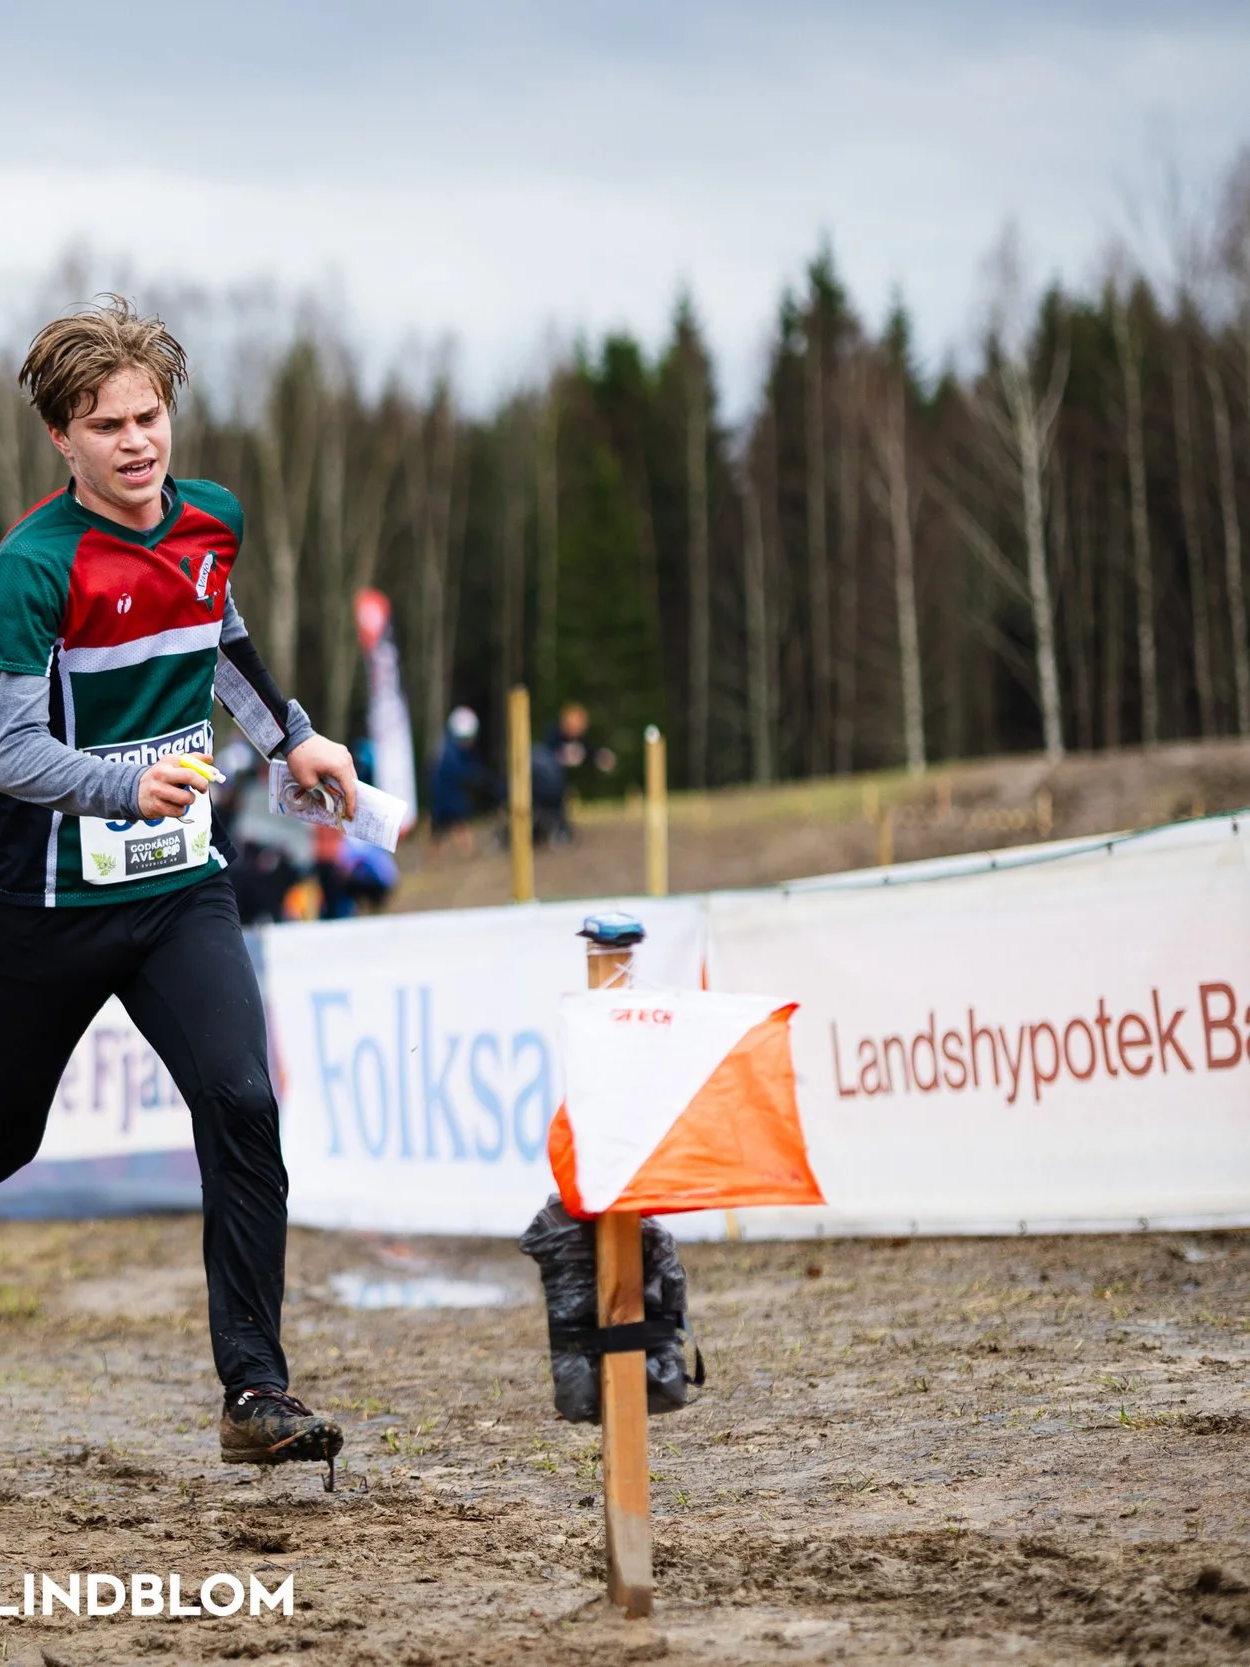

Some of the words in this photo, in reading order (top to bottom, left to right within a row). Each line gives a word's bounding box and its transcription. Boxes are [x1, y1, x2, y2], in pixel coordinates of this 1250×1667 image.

[130, 835, 181, 853] GODKÄNDA
[310, 982, 553, 1164] Folksa
[830, 987, 1194, 1104] Landshypotek
[1199, 982, 1250, 1069] B
